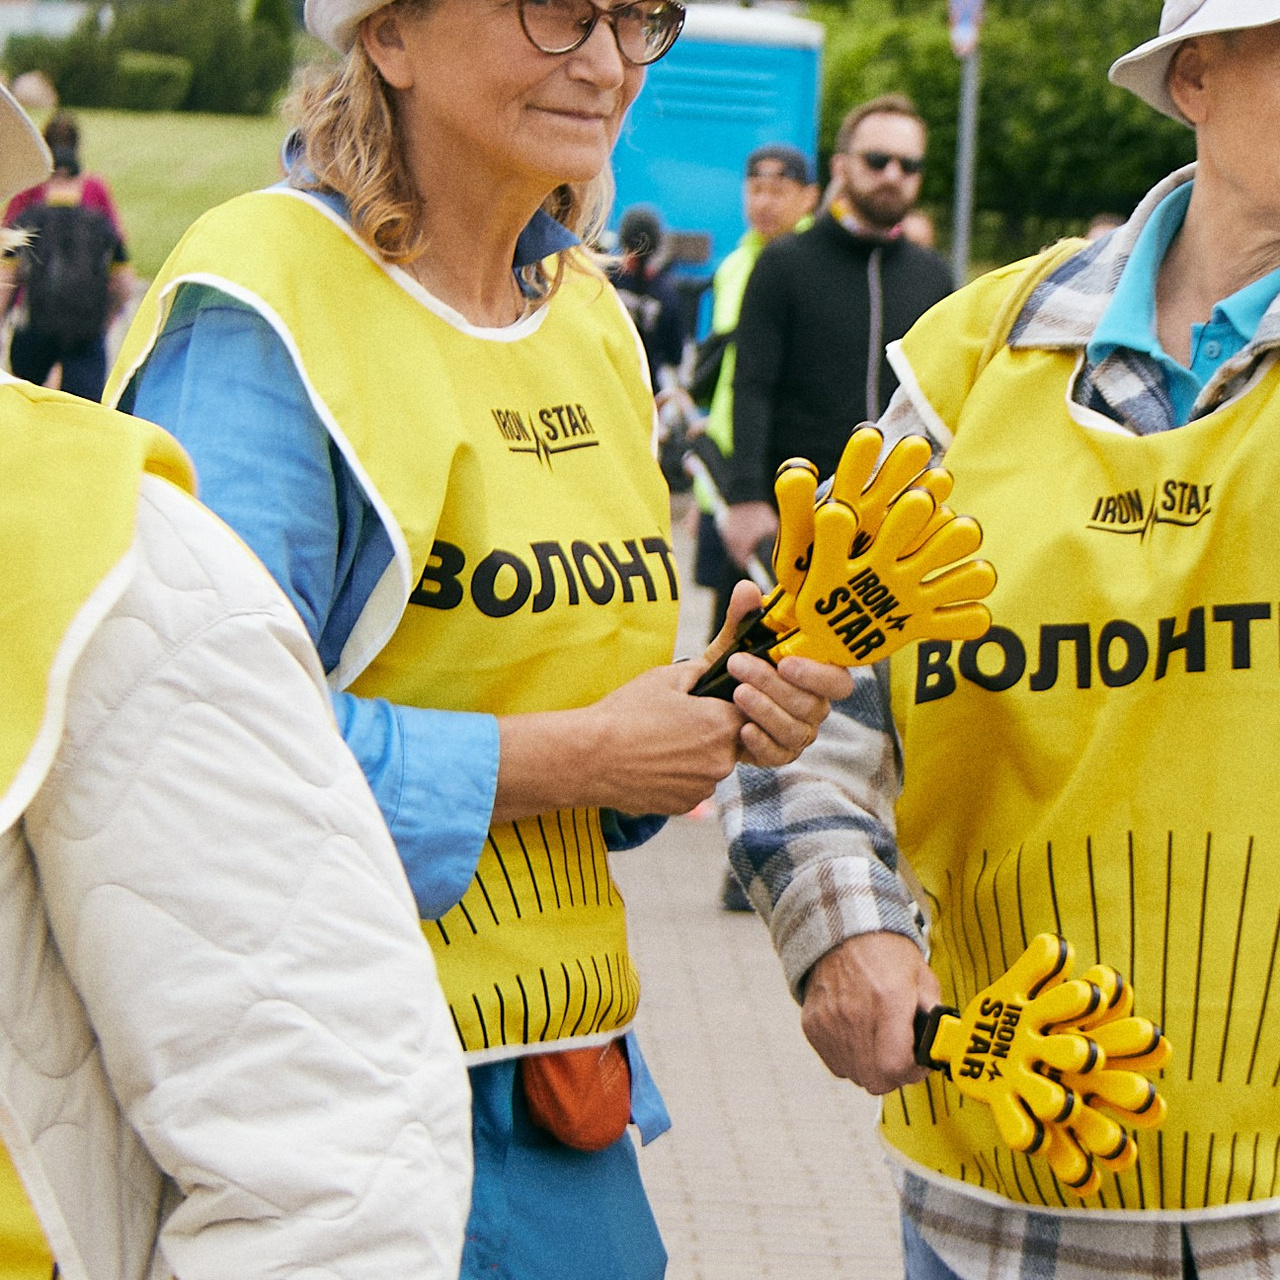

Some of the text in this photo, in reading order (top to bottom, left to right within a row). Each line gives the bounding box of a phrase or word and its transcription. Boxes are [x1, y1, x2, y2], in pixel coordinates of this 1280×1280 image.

[491, 403, 595, 441] IRON STAR
[1091, 488, 1144, 524] IRON
[409, 535, 679, 618] ВОЛОНТ
[847, 566, 899, 619] IRON
[814, 586, 886, 660] STAR
[958, 996, 1004, 1080] STAR
[990, 1003, 1023, 1059] IRON
